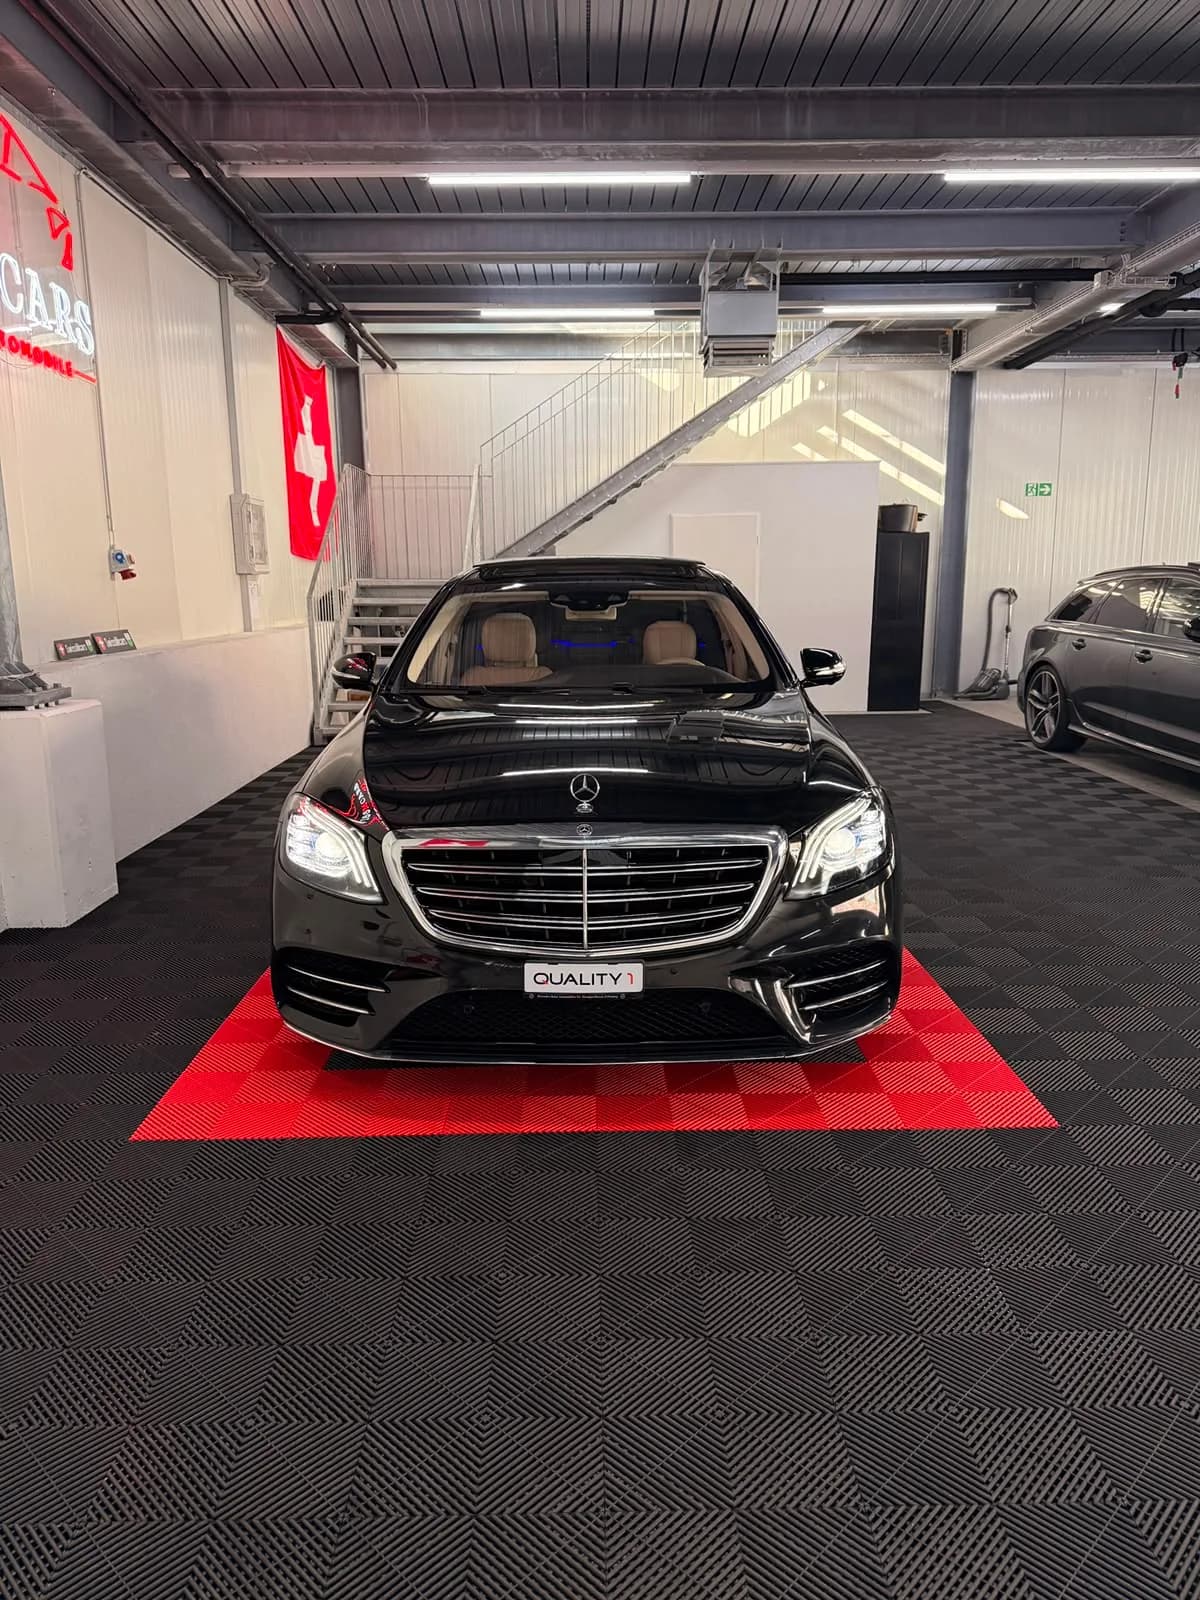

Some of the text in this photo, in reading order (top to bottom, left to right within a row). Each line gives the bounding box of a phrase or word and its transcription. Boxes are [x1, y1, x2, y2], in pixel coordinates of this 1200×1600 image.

[0, 253, 95, 356] CARS
[533, 972, 634, 986] QUALITY 1
